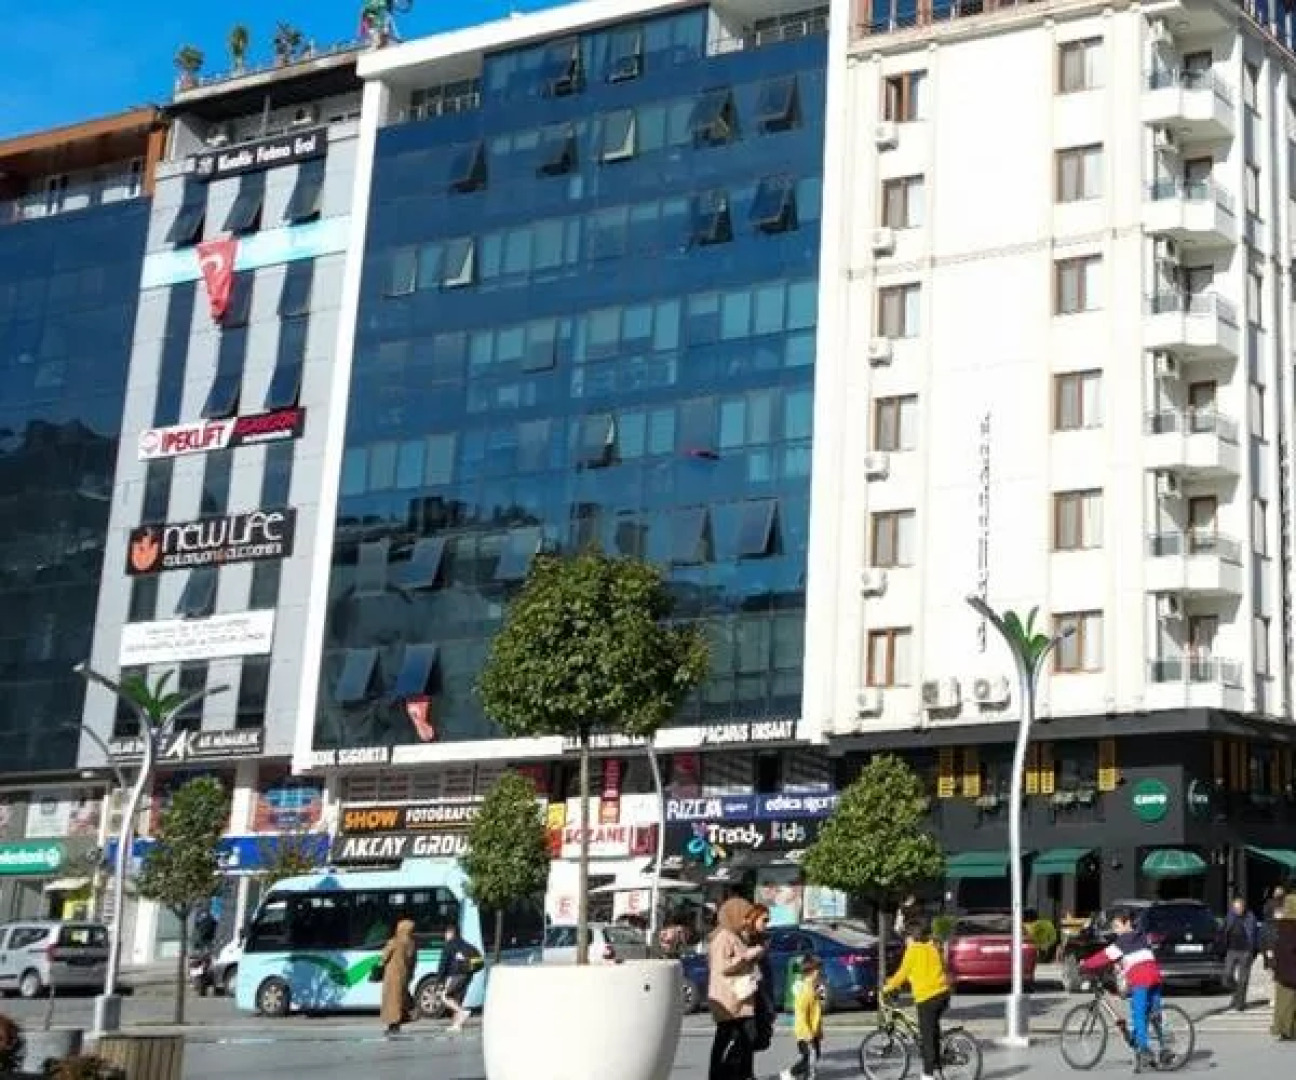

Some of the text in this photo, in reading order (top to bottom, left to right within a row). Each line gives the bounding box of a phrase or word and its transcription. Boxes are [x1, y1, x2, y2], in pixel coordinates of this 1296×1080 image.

[344, 809, 399, 830] SHOW
[412, 834, 472, 856] GROU
[708, 822, 764, 848] Trendy
